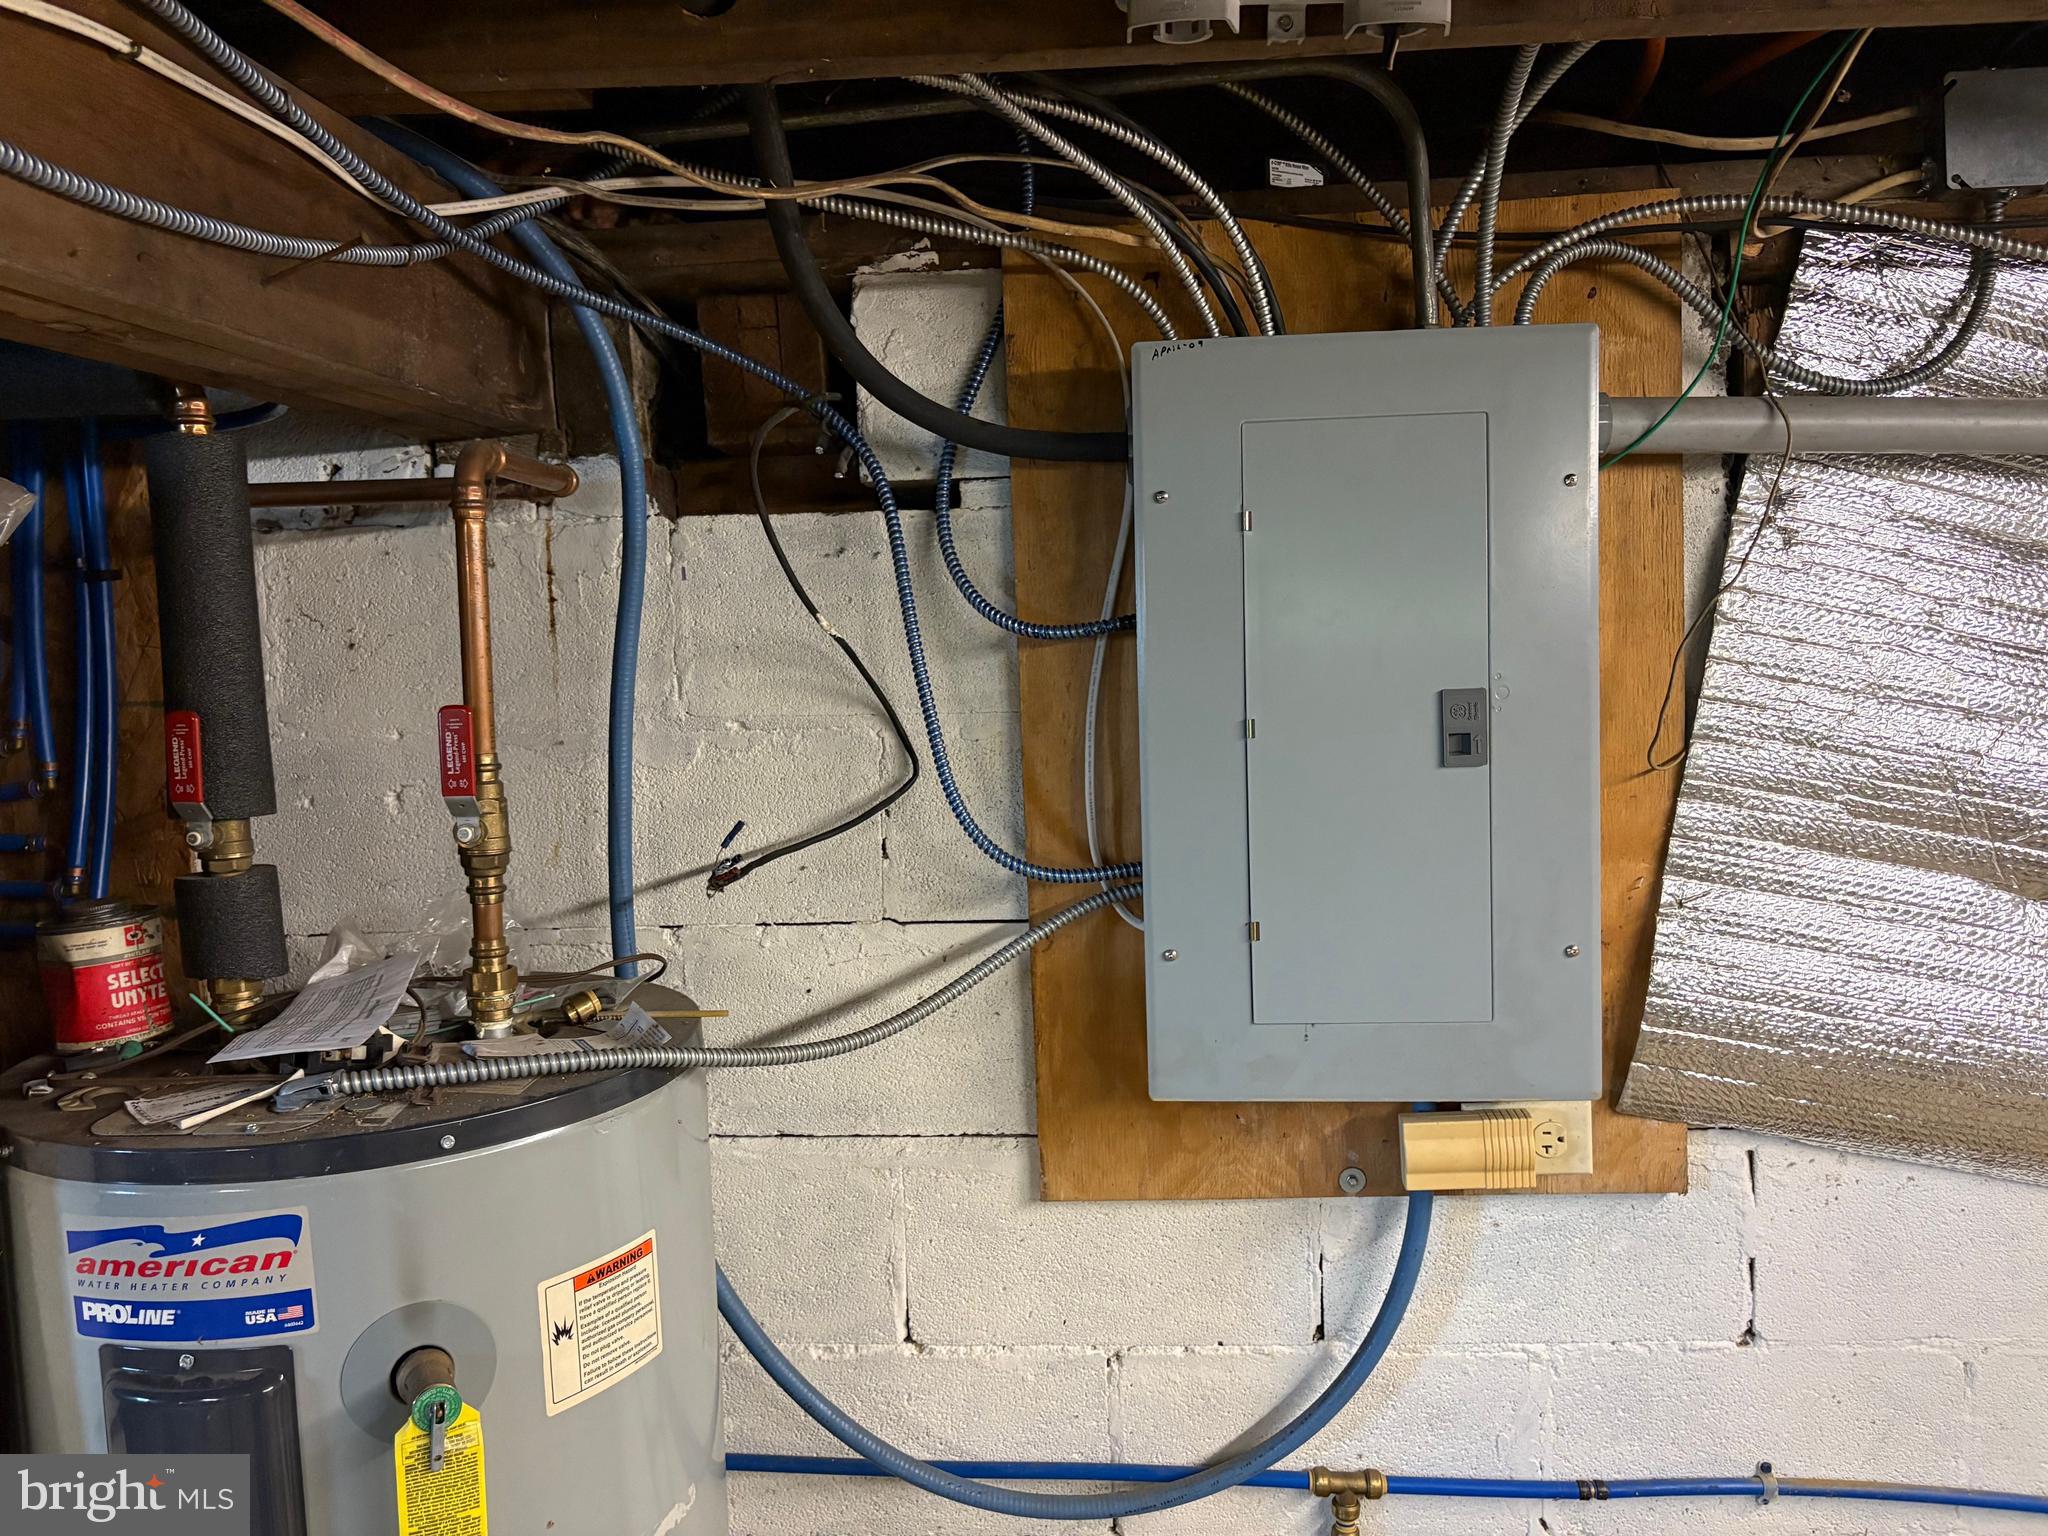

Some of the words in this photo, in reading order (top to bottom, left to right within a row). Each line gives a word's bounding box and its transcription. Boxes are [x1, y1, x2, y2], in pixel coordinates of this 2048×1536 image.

[172, 737, 180, 780] LEGEND
[445, 731, 454, 775] LEGEND
[106, 962, 164, 990] SELECT
[110, 983, 167, 1008] UNYTE
[96, 1017, 136, 1030] CONTAINS
[76, 1250, 292, 1278] american
[595, 1247, 643, 1279] WARNING
[598, 1273, 620, 1288] Explosion
[621, 1264, 636, 1275] Hazard
[77, 1279, 120, 1291] WATER
[130, 1280, 189, 1291] HEATER
[201, 1273, 288, 1290] COMPANY
[592, 1282, 619, 1300] temperature
[629, 1268, 646, 1280] pressure
[579, 1303, 592, 1314] relief
[593, 1297, 605, 1307] valve
[611, 1284, 629, 1298] dripping
[579, 1311, 591, 1321] have
[597, 1298, 616, 1312] qualified
[617, 1290, 632, 1301] person
[633, 1282, 646, 1293] replace
[580, 1313, 603, 1330] Examples
[615, 1299, 632, 1312] qualified
[633, 1291, 646, 1301] person
[82, 1301, 176, 1326] PROLINE
[245, 1313, 278, 1325] USA
[601, 1312, 620, 1326] licensed
[581, 1327, 606, 1344] authorized
[616, 1312, 634, 1326] company
[592, 1328, 616, 1345] authorized
[617, 1320, 632, 1331] service
[599, 1342, 610, 1352] plug
[600, 1346, 617, 1359] remove
[583, 1364, 600, 1377] Failure
[607, 1353, 620, 1364] follow
[622, 1345, 633, 1355] these
[594, 1368, 607, 1379] result
[614, 1356, 626, 1367] death
